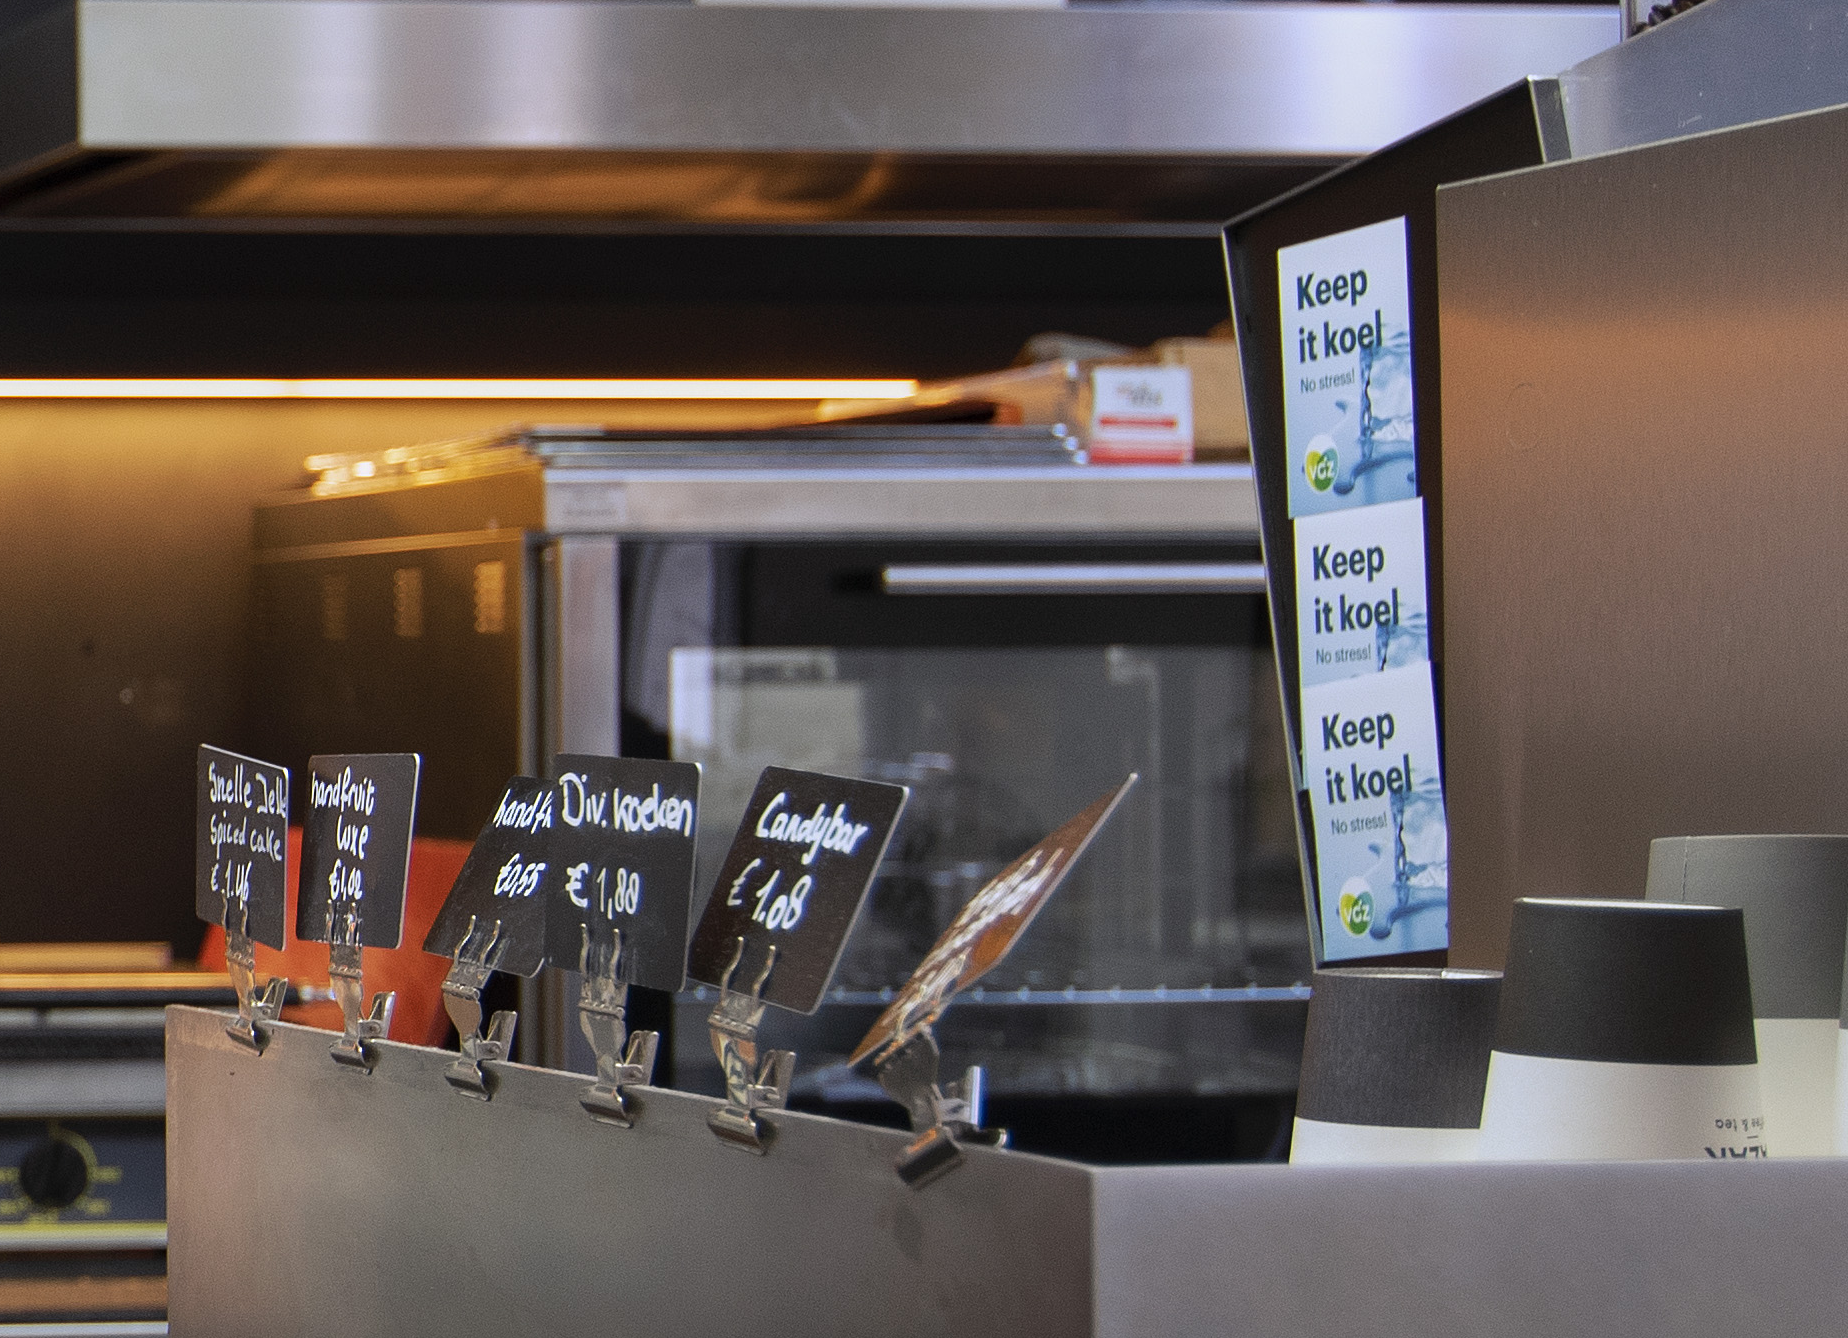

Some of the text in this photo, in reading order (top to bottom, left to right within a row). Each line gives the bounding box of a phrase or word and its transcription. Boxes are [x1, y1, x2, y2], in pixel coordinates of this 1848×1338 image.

[1296, 267, 1368, 311] Keep
[1299, 309, 1384, 363] it koel
[1301, 367, 1355, 394] No stress!
[1313, 544, 1384, 583] Keep
[1314, 587, 1399, 634] it koel
[1316, 643, 1371, 665] No stress!
[1322, 712, 1395, 751] Keep
[208, 761, 253, 809] Snelle
[310, 766, 375, 817] handfruit
[1325, 753, 1412, 805] it koel
[492, 788, 554, 835] handfr
[558, 772, 693, 837] Div. koeken
[1331, 811, 1388, 835] No stress!
[210, 810, 282, 862] Spiced cake
[756, 791, 869, 866] Candybar
[565, 862, 590, 908] €
[726, 858, 762, 907] €
